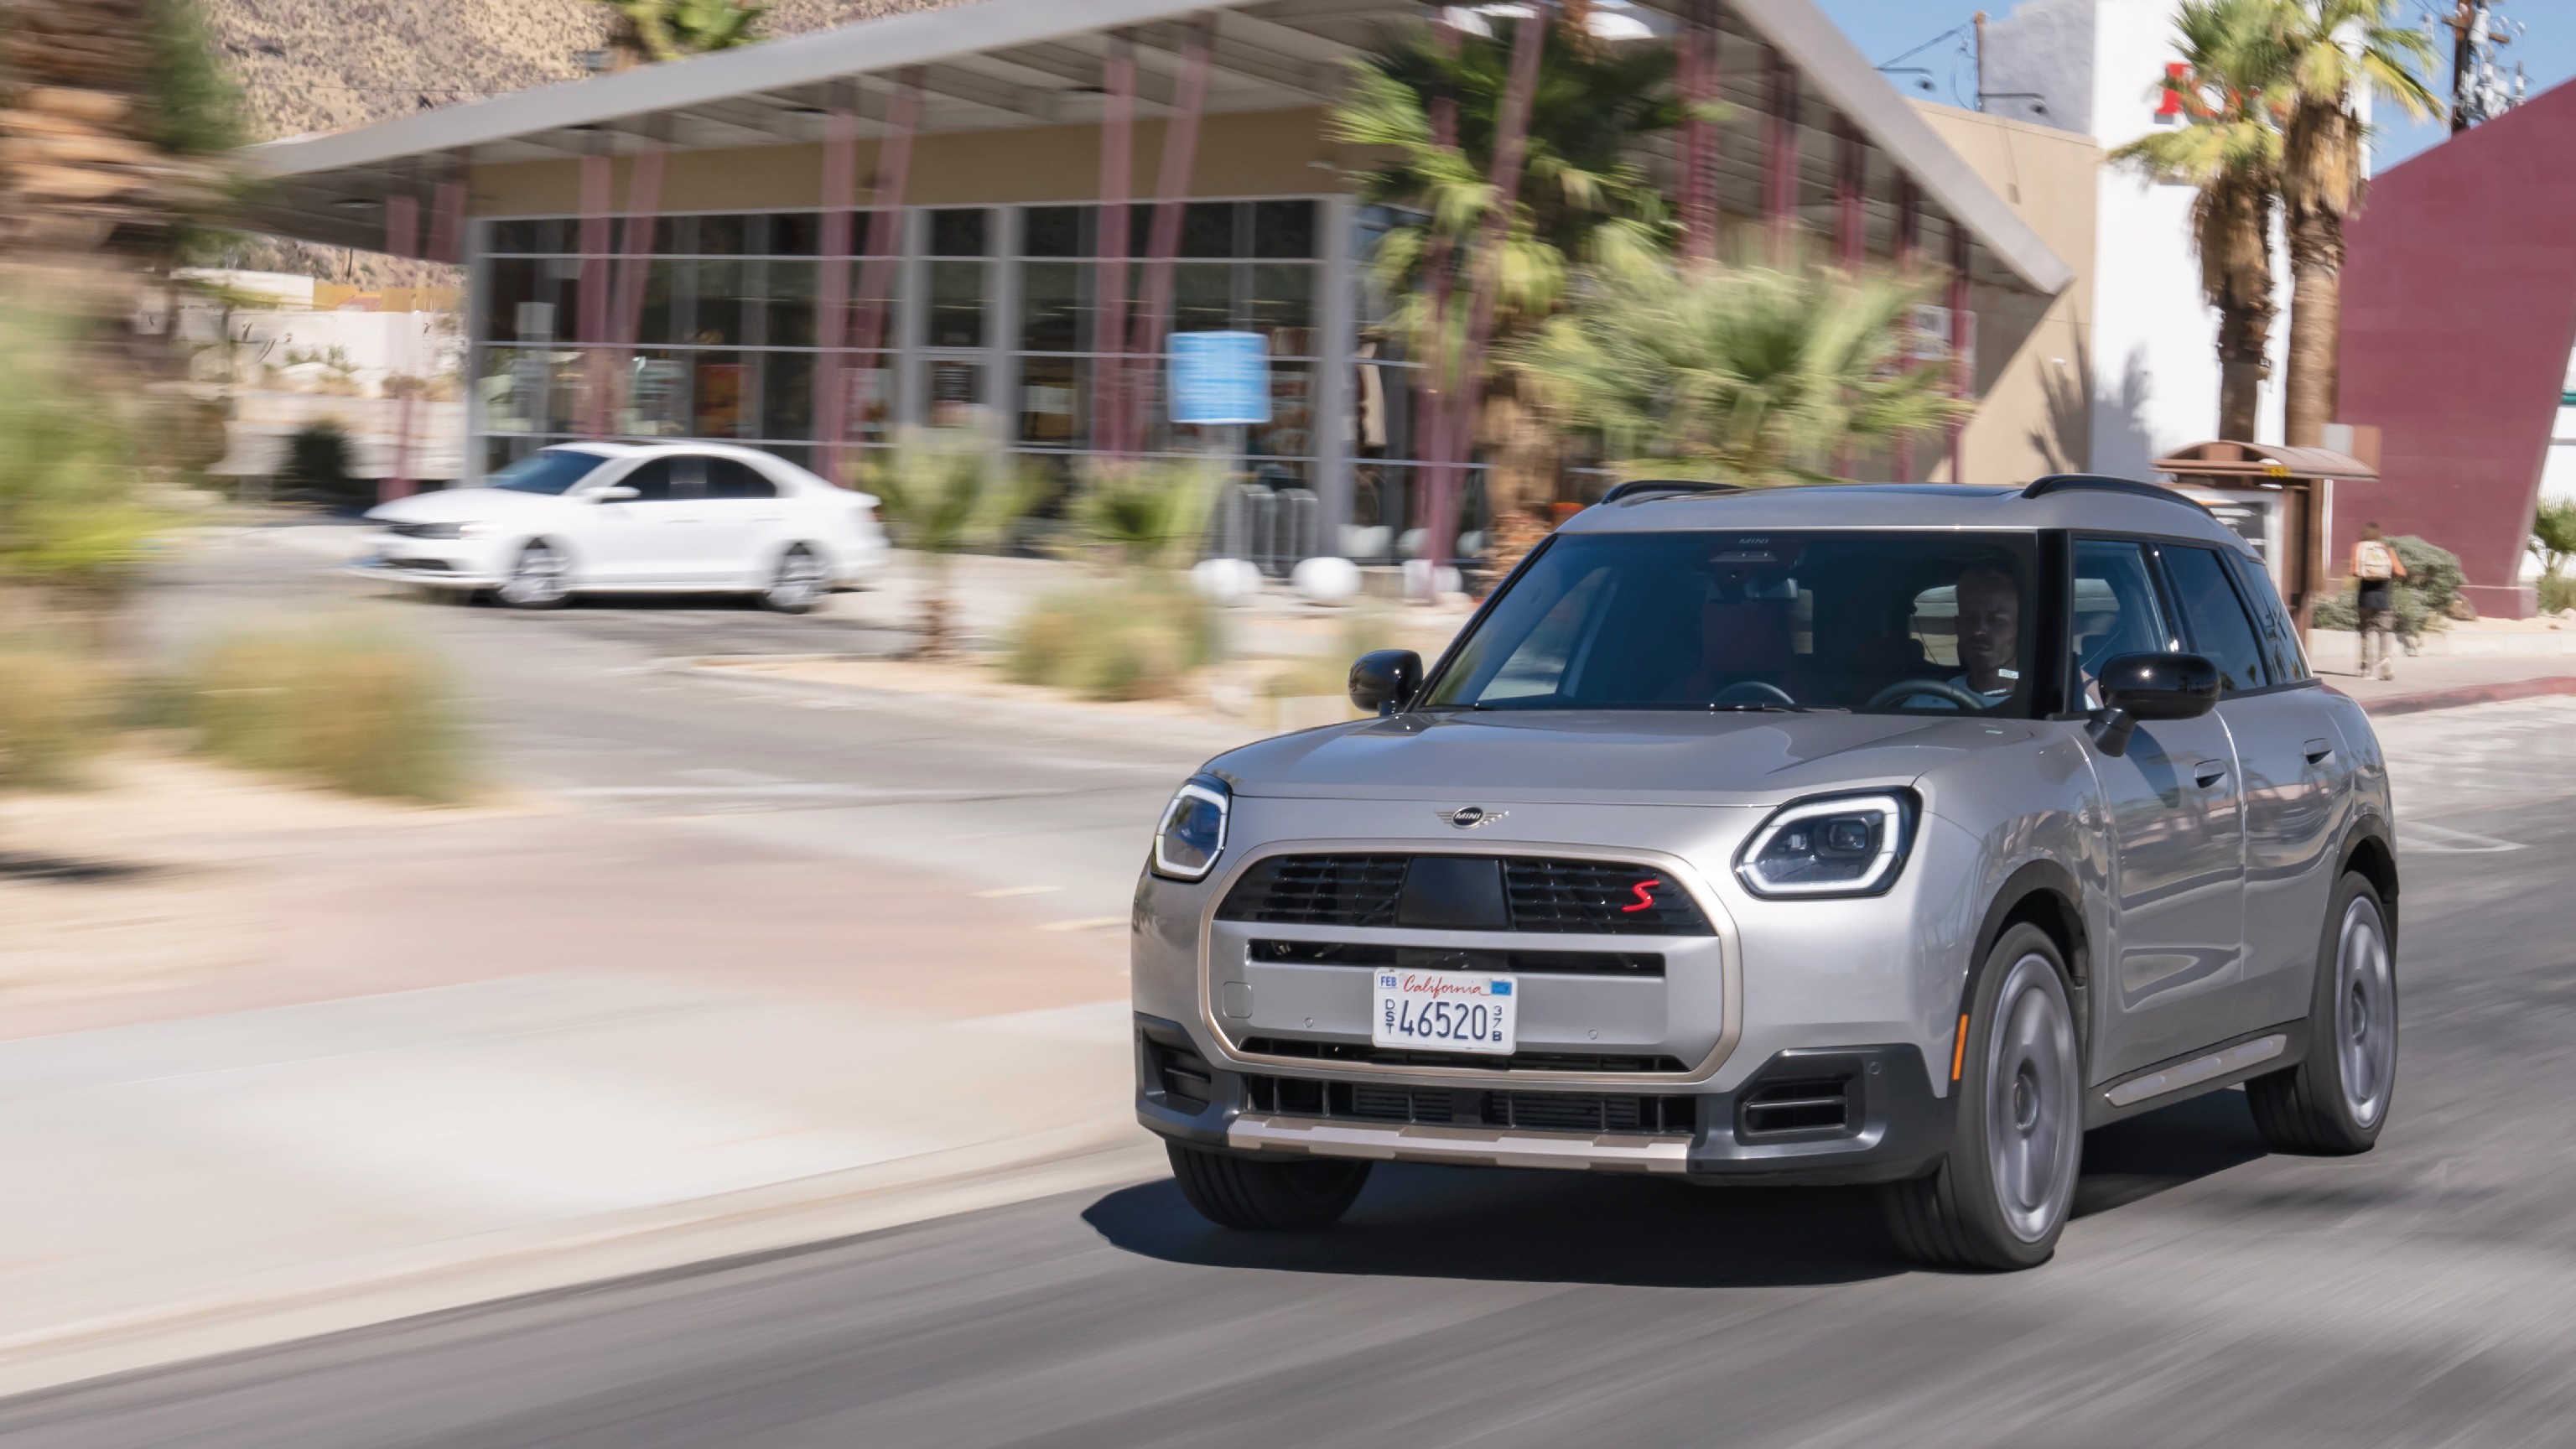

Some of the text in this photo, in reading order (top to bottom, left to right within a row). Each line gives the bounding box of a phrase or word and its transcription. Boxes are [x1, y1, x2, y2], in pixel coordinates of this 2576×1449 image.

[1622, 880, 1659, 912] S
[1381, 976, 1397, 987] FEB
[1404, 974, 1492, 999] California
[1400, 1000, 1488, 1041] 46520
